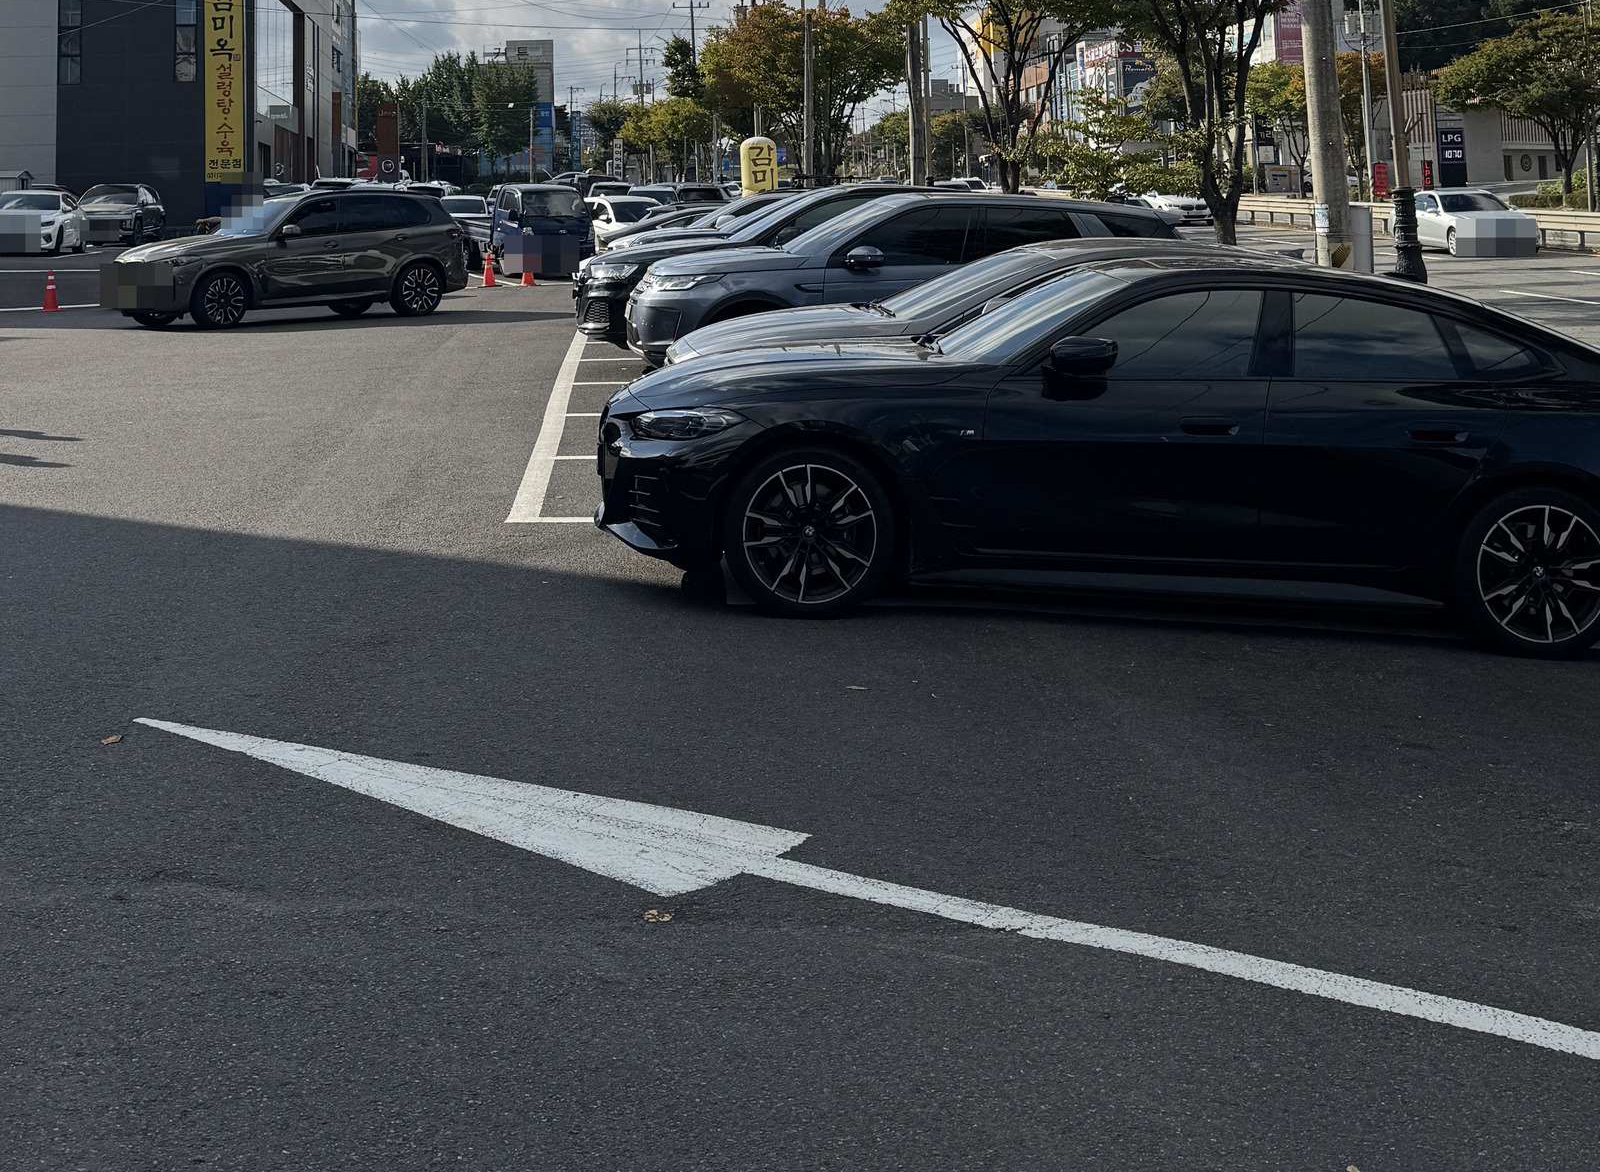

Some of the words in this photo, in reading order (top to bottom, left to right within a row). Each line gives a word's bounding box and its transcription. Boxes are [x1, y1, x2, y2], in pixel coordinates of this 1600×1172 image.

[1442, 134, 1461, 142] LPG
[1445, 149, 1462, 158] 1070
[208, 158, 242, 169] 전문점
[748, 144, 775, 191] 감미
